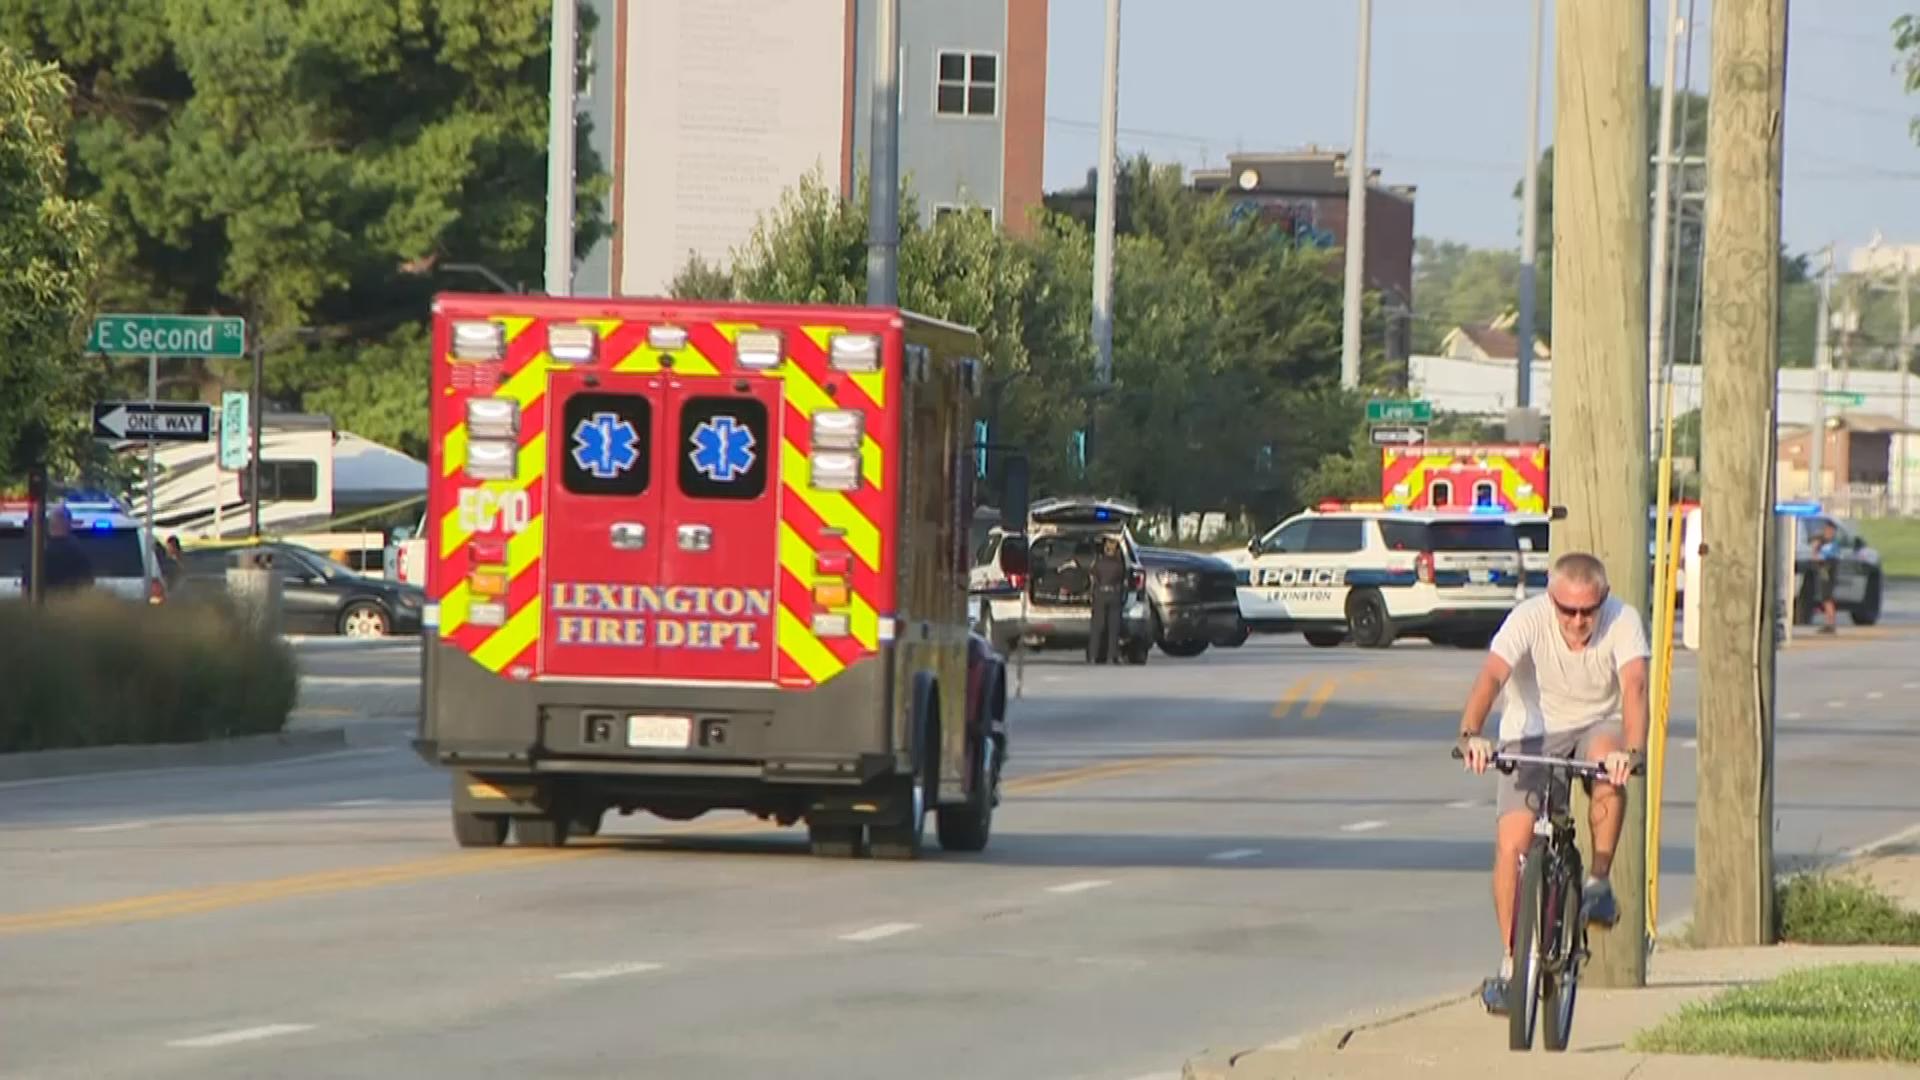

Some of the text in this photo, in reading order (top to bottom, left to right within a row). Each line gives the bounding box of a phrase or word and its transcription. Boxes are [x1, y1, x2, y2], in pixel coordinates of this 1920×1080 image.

[98, 322, 114, 349] E
[122, 322, 214, 350] Second
[128, 415, 197, 431] ONE WAY
[458, 488, 529, 533] EC10
[1262, 568, 1344, 586] POLICE
[551, 583, 772, 615] LEXINGTON
[1266, 590, 1332, 602] LEXINGTON
[557, 616, 645, 645] FIRE
